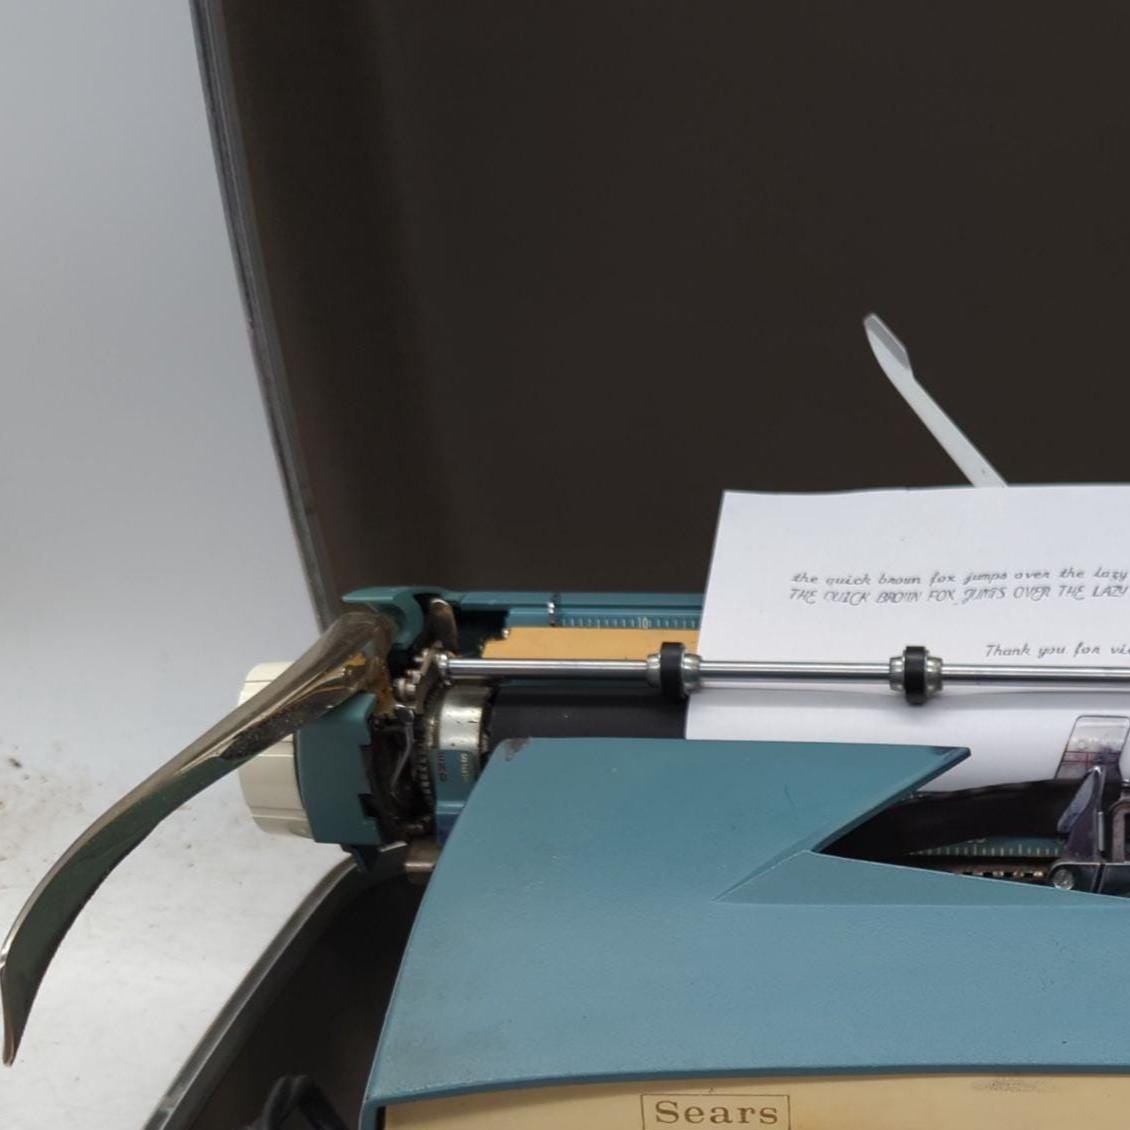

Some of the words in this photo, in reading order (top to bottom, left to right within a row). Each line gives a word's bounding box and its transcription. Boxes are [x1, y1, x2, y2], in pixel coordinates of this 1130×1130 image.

[790, 572, 818, 584] the
[825, 574, 871, 586] quick
[878, 573, 921, 585] brown
[929, 572, 956, 586] fox
[963, 572, 1008, 586] jumps
[1014, 571, 1050, 581] over
[1059, 567, 1085, 579] the
[1094, 567, 1127, 581] lazy
[788, 588, 818, 604] THE
[822, 589, 871, 606] QUICK
[876, 590, 922, 604] BROWN
[928, 588, 956, 602] FOX
[1013, 586, 1051, 602] OVER
[1058, 585, 1085, 600] THE
[1092, 585, 1127, 599] LAZY
[985, 644, 1030, 658] Thank
[1037, 647, 1066, 660] you
[1073, 642, 1101, 658] for
[655, 1100, 778, 1125] Sears
